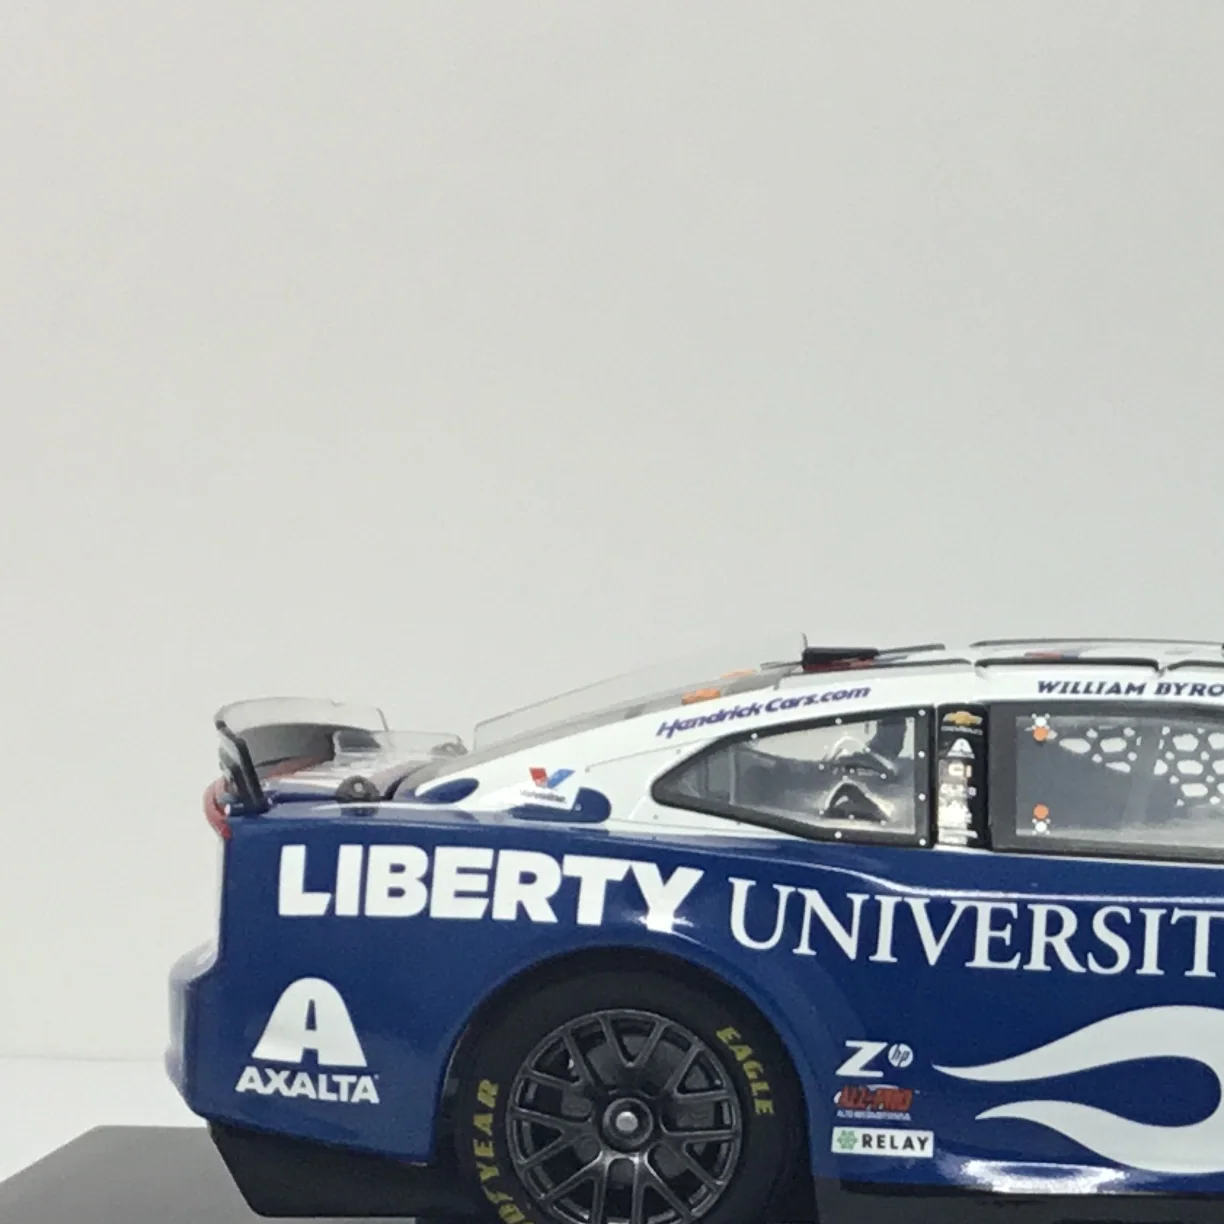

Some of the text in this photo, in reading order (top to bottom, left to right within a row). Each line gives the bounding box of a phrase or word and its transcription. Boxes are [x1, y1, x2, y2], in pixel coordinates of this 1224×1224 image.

[1037, 680, 1147, 697] WILLIAM
[277, 843, 704, 934] LIBERTY
[715, 1025, 776, 1117] EAGLE
[835, 1040, 888, 1078] Z
[234, 1065, 381, 1105] AXALTA
[861, 1133, 929, 1152] RELAY
